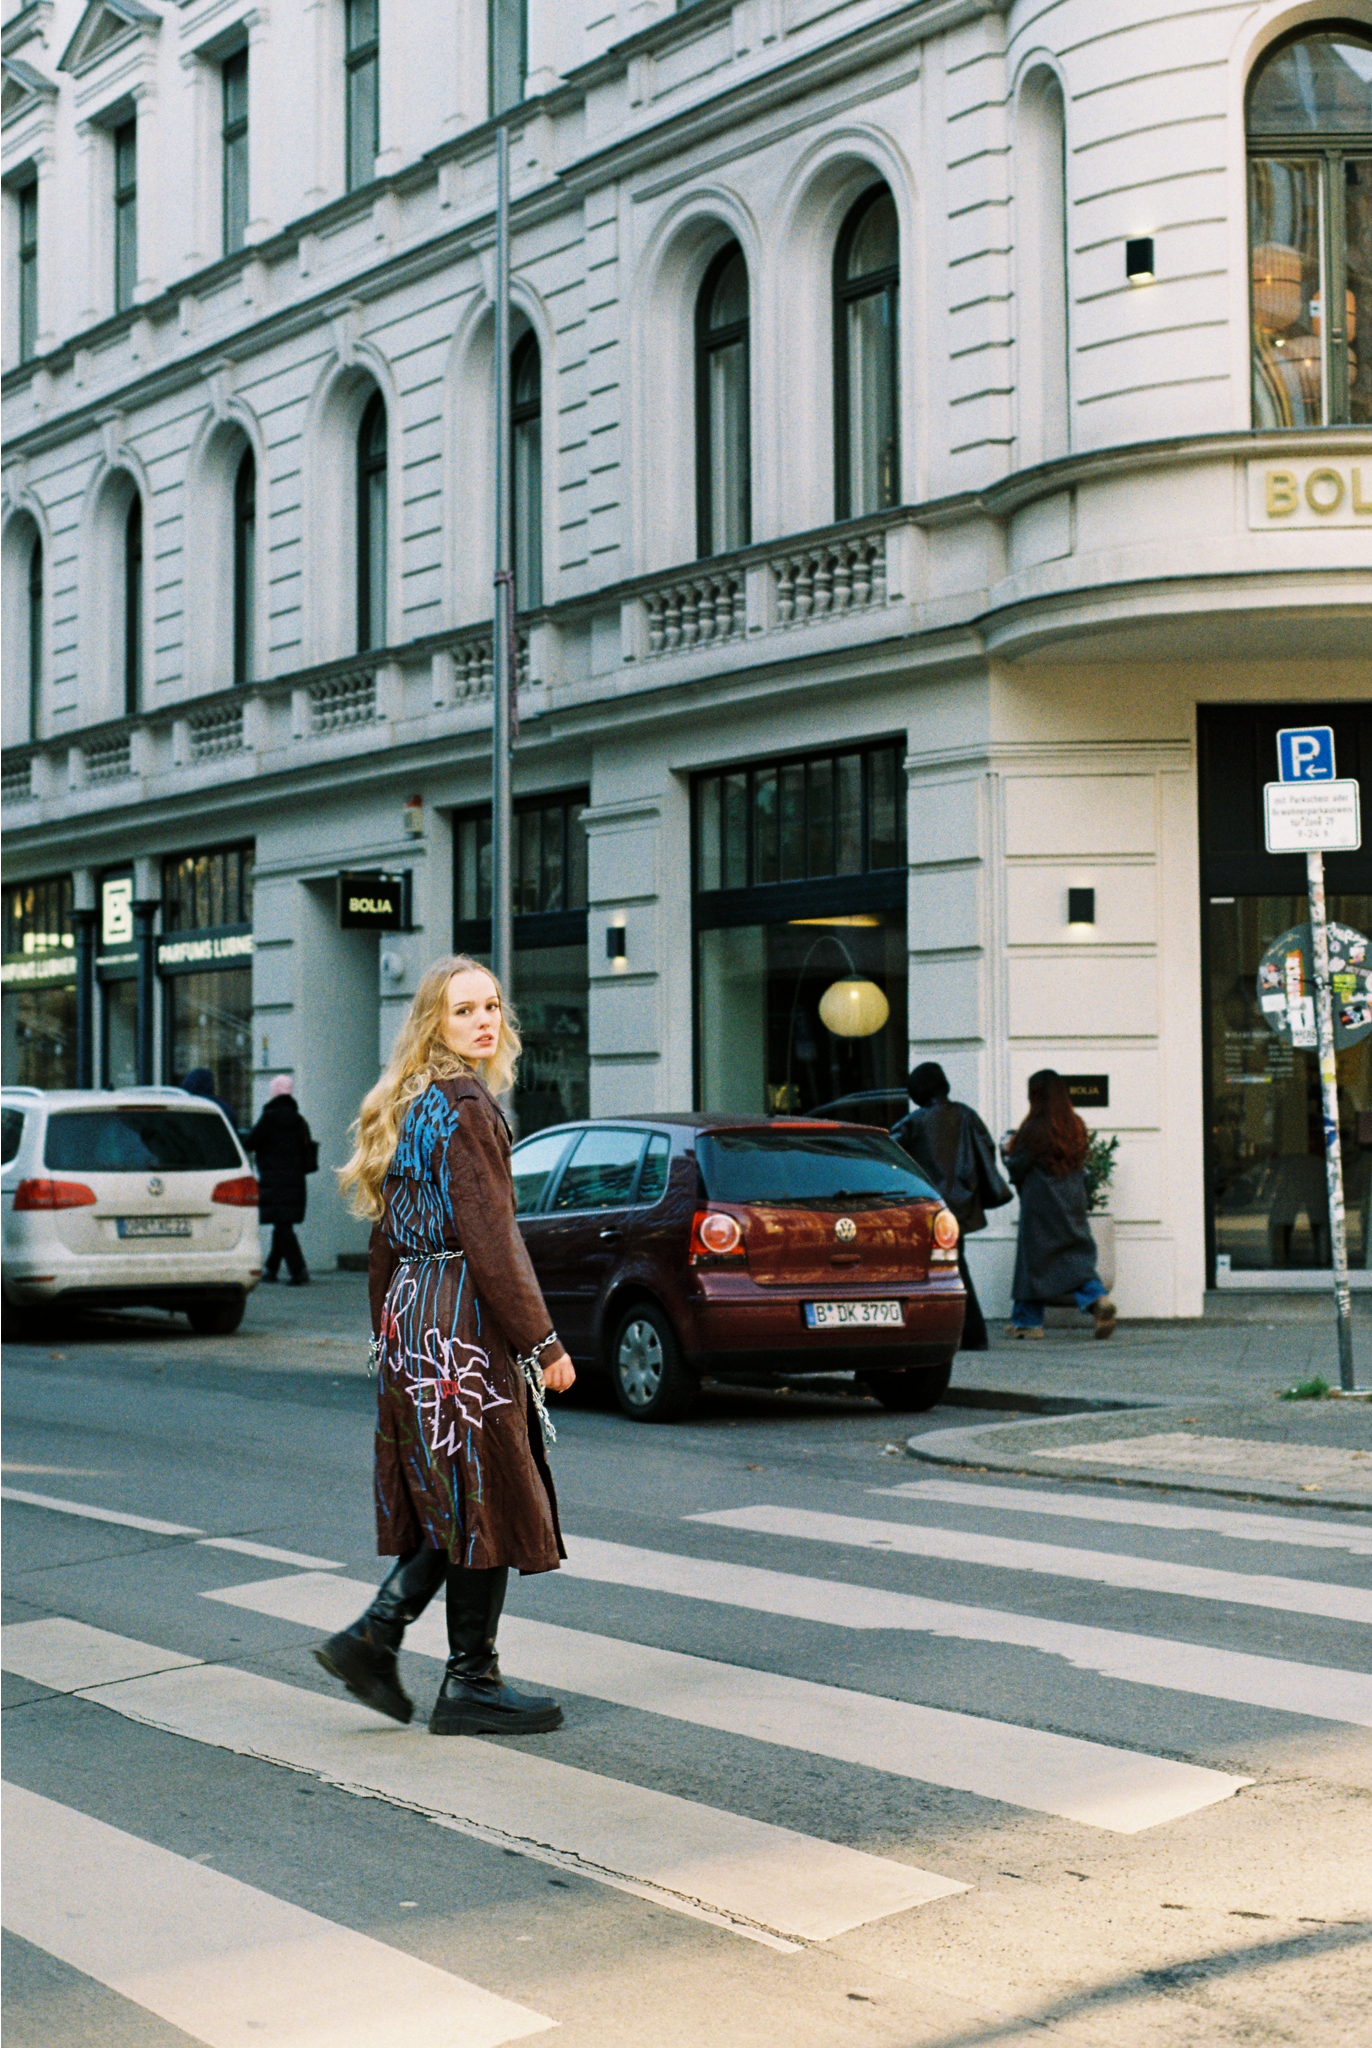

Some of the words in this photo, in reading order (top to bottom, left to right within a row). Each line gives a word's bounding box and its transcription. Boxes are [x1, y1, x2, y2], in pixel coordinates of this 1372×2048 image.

[1265, 467, 1372, 519] BOL
[1290, 735, 1320, 777] P
[349, 897, 393, 913] BOLIA
[815, 1305, 827, 1322] B
[837, 1304, 858, 1322] DK
